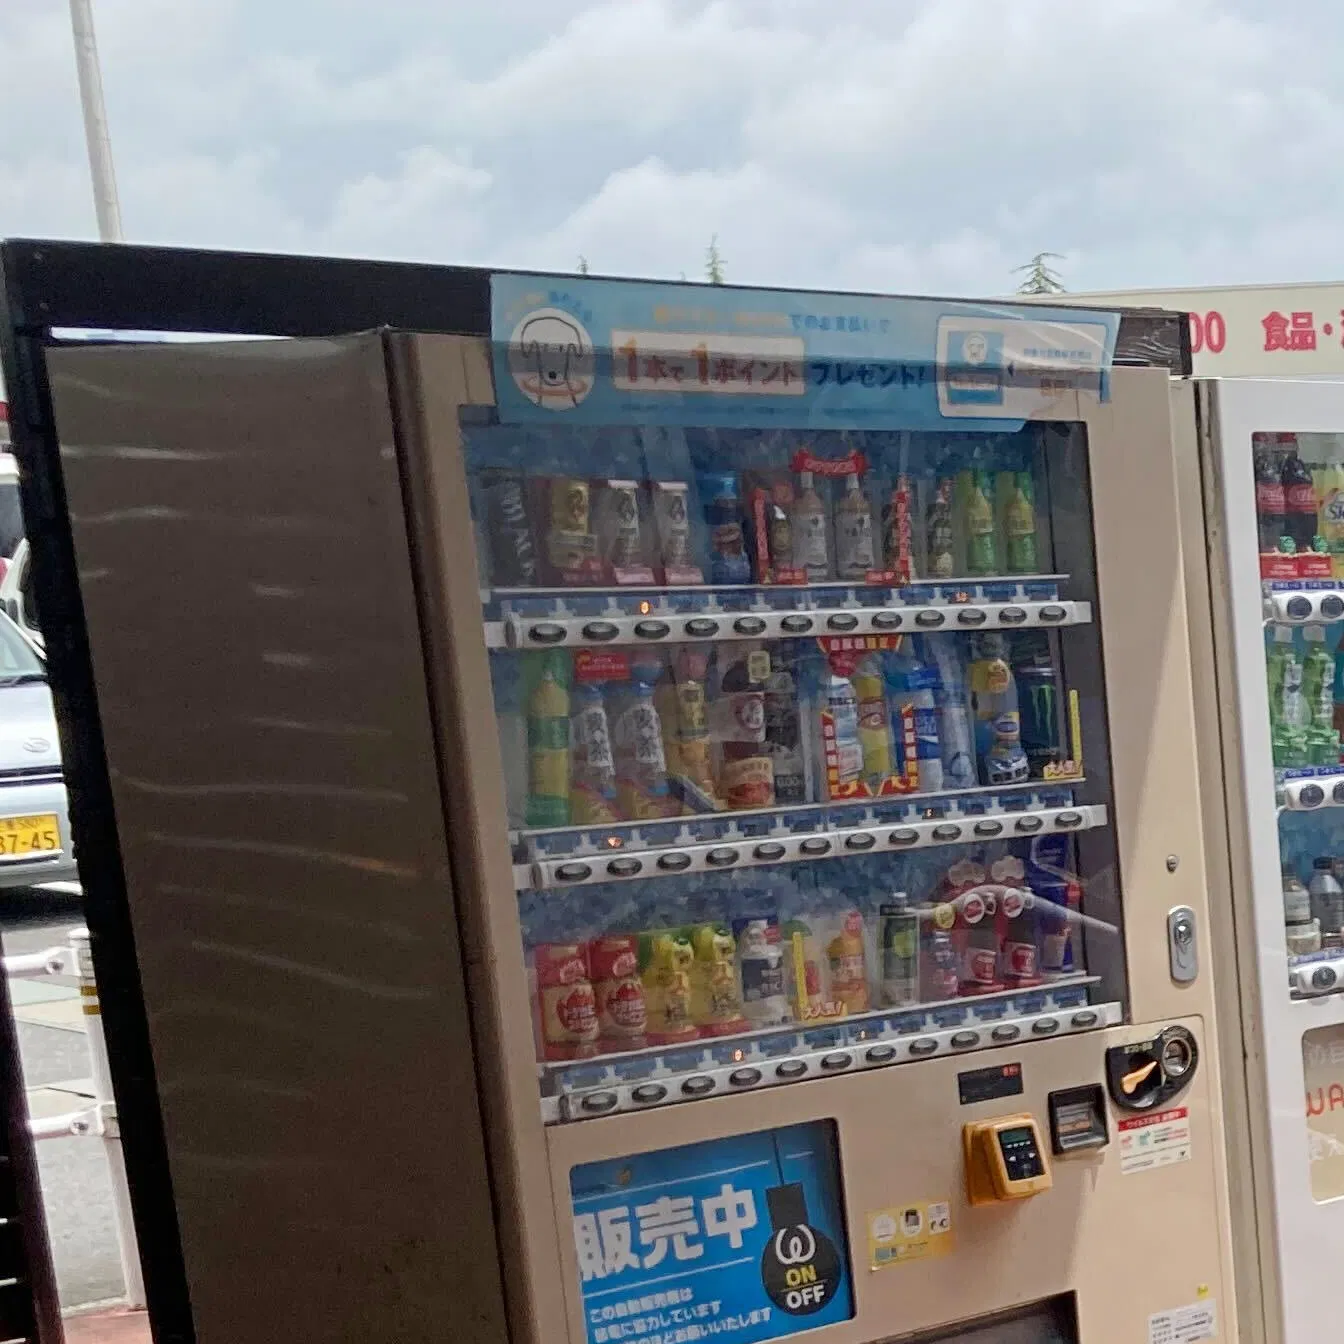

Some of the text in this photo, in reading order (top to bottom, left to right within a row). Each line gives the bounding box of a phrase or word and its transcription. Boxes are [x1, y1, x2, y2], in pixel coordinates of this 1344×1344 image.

[573, 1182, 758, 1282] 販売中
[784, 1264, 818, 1288] ON
[785, 1283, 826, 1310] OFF
